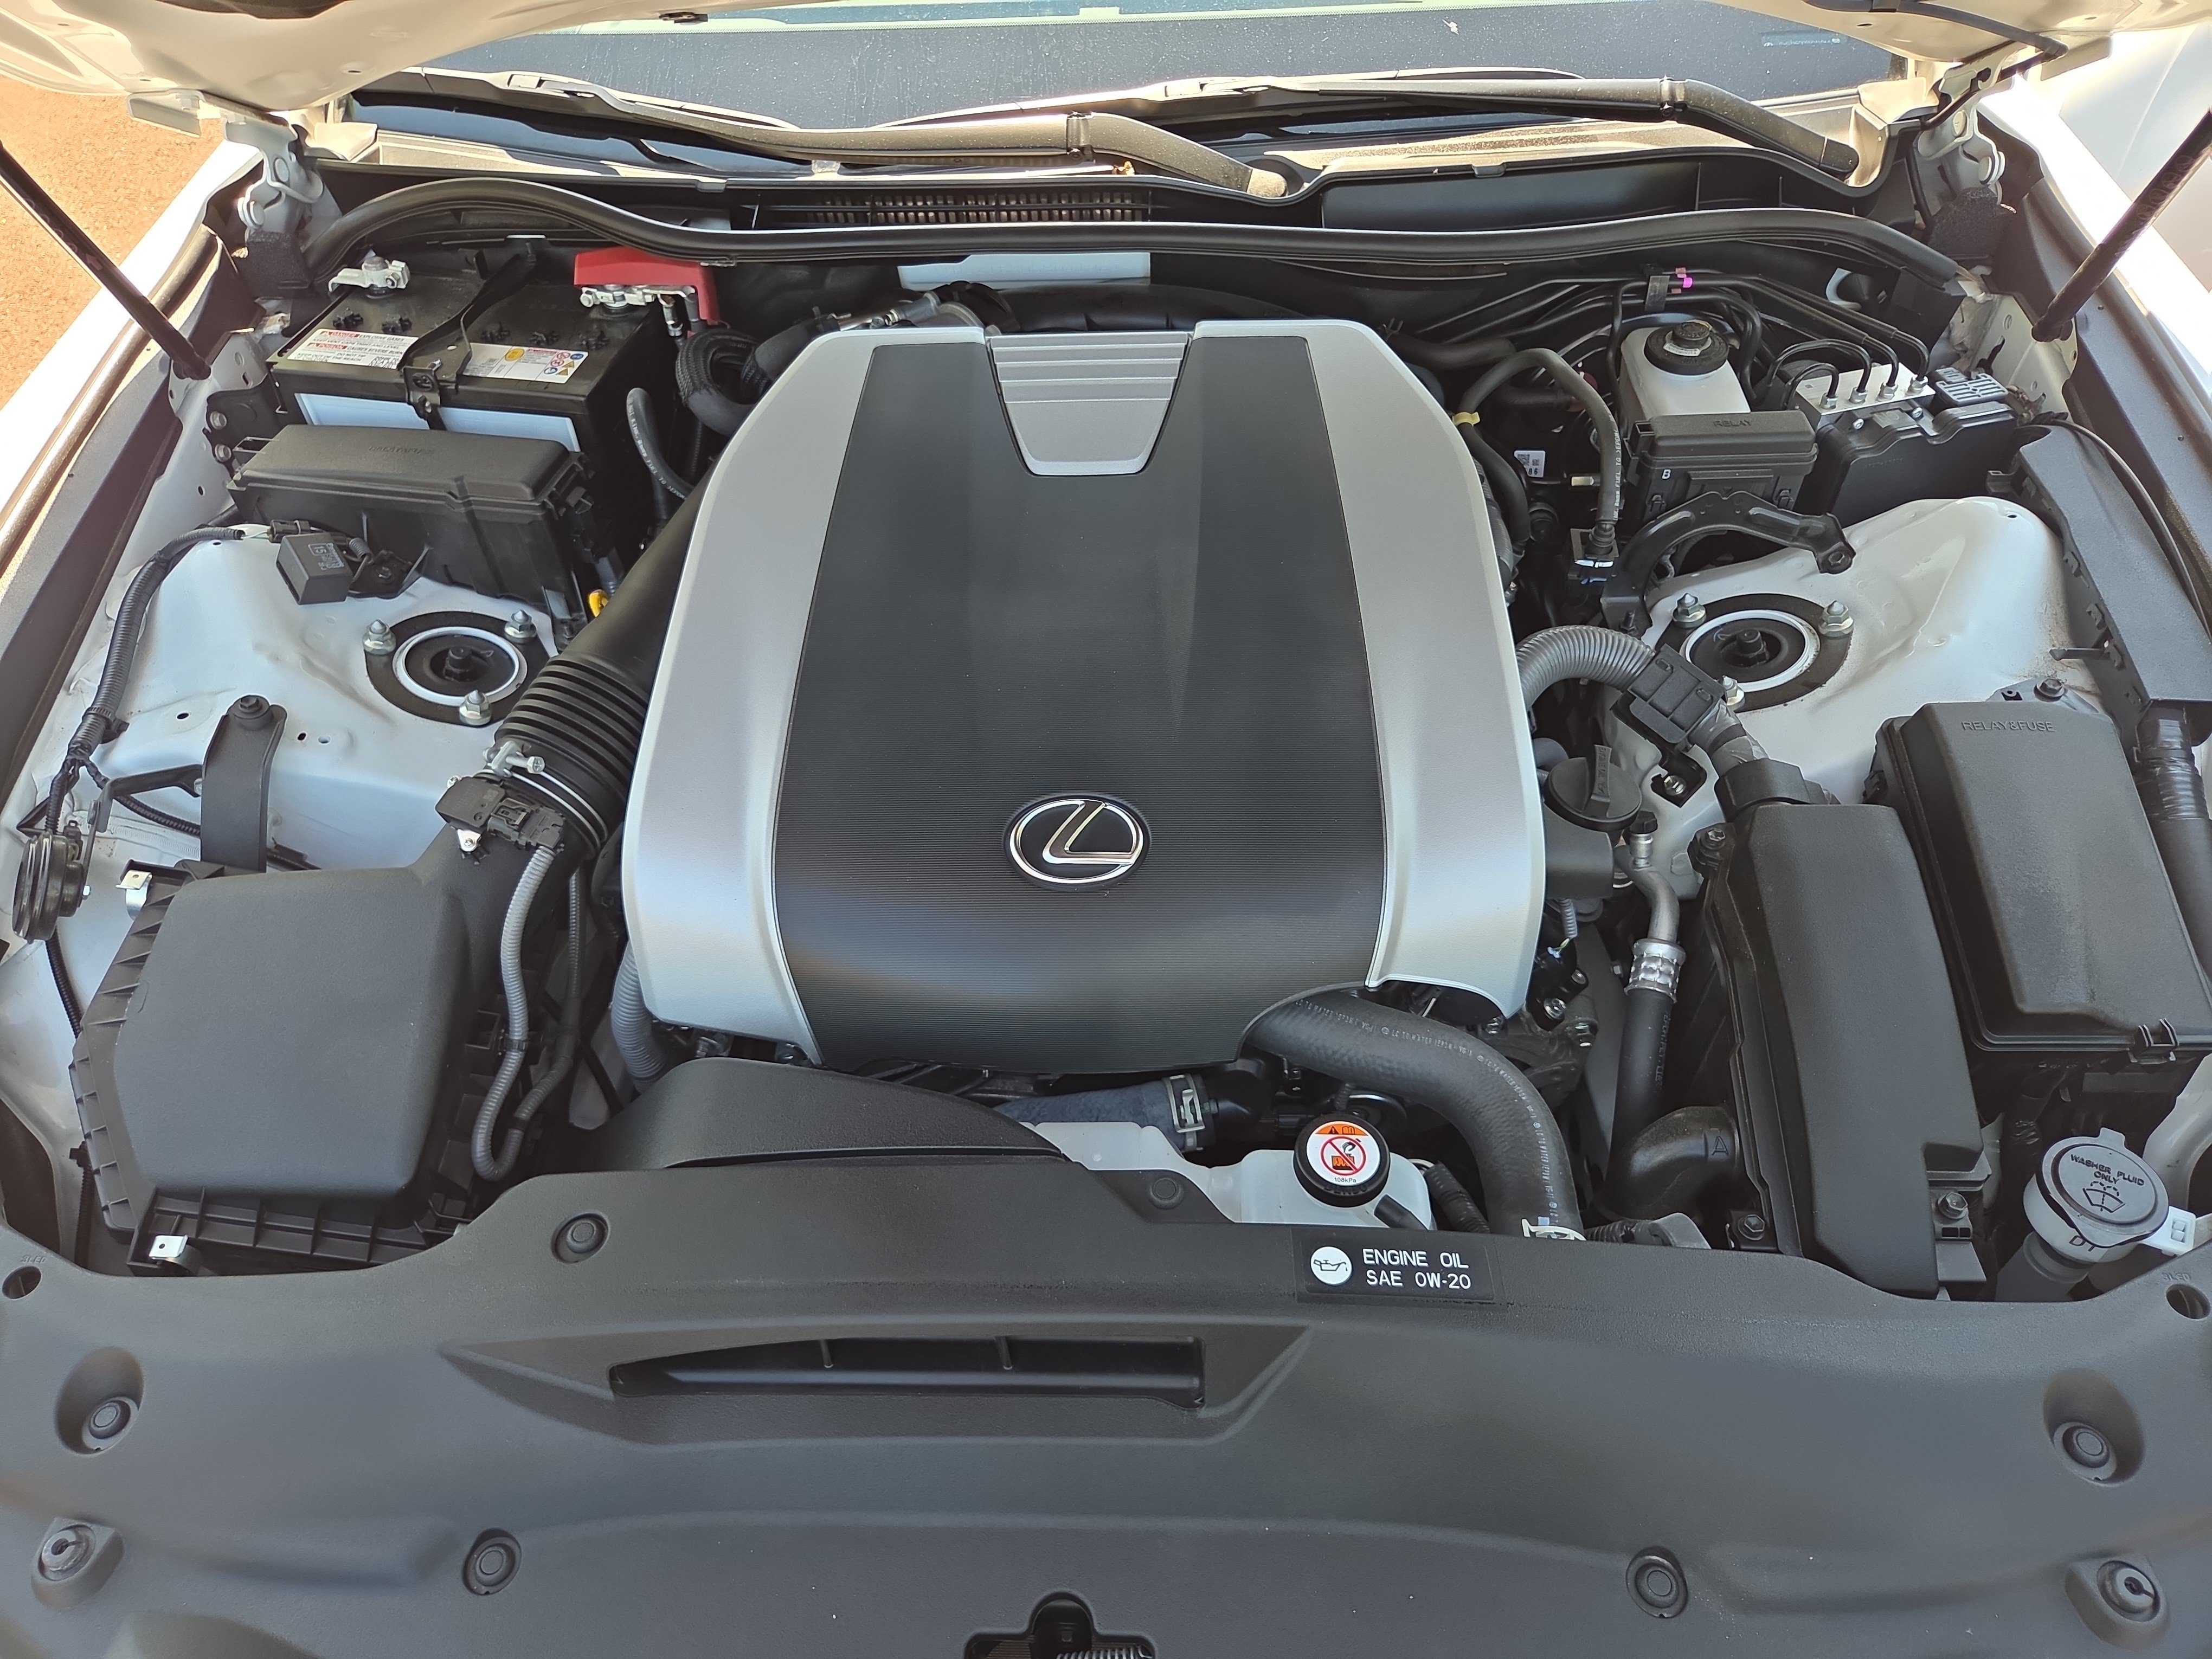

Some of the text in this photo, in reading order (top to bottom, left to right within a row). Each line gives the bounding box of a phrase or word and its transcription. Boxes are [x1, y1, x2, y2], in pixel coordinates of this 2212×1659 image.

[1713, 419, 1751, 427] RELAY
[1661, 468, 1672, 480] B
[1960, 721, 2055, 732] RELAY&FUSE
[2070, 1153, 2145, 1186] WASHER FLUID
[2093, 1171, 2120, 1185] ONLY
[1362, 1248, 1469, 1269] ENGINE OIL
[1365, 1269, 1471, 1290] SAE 0W-20
